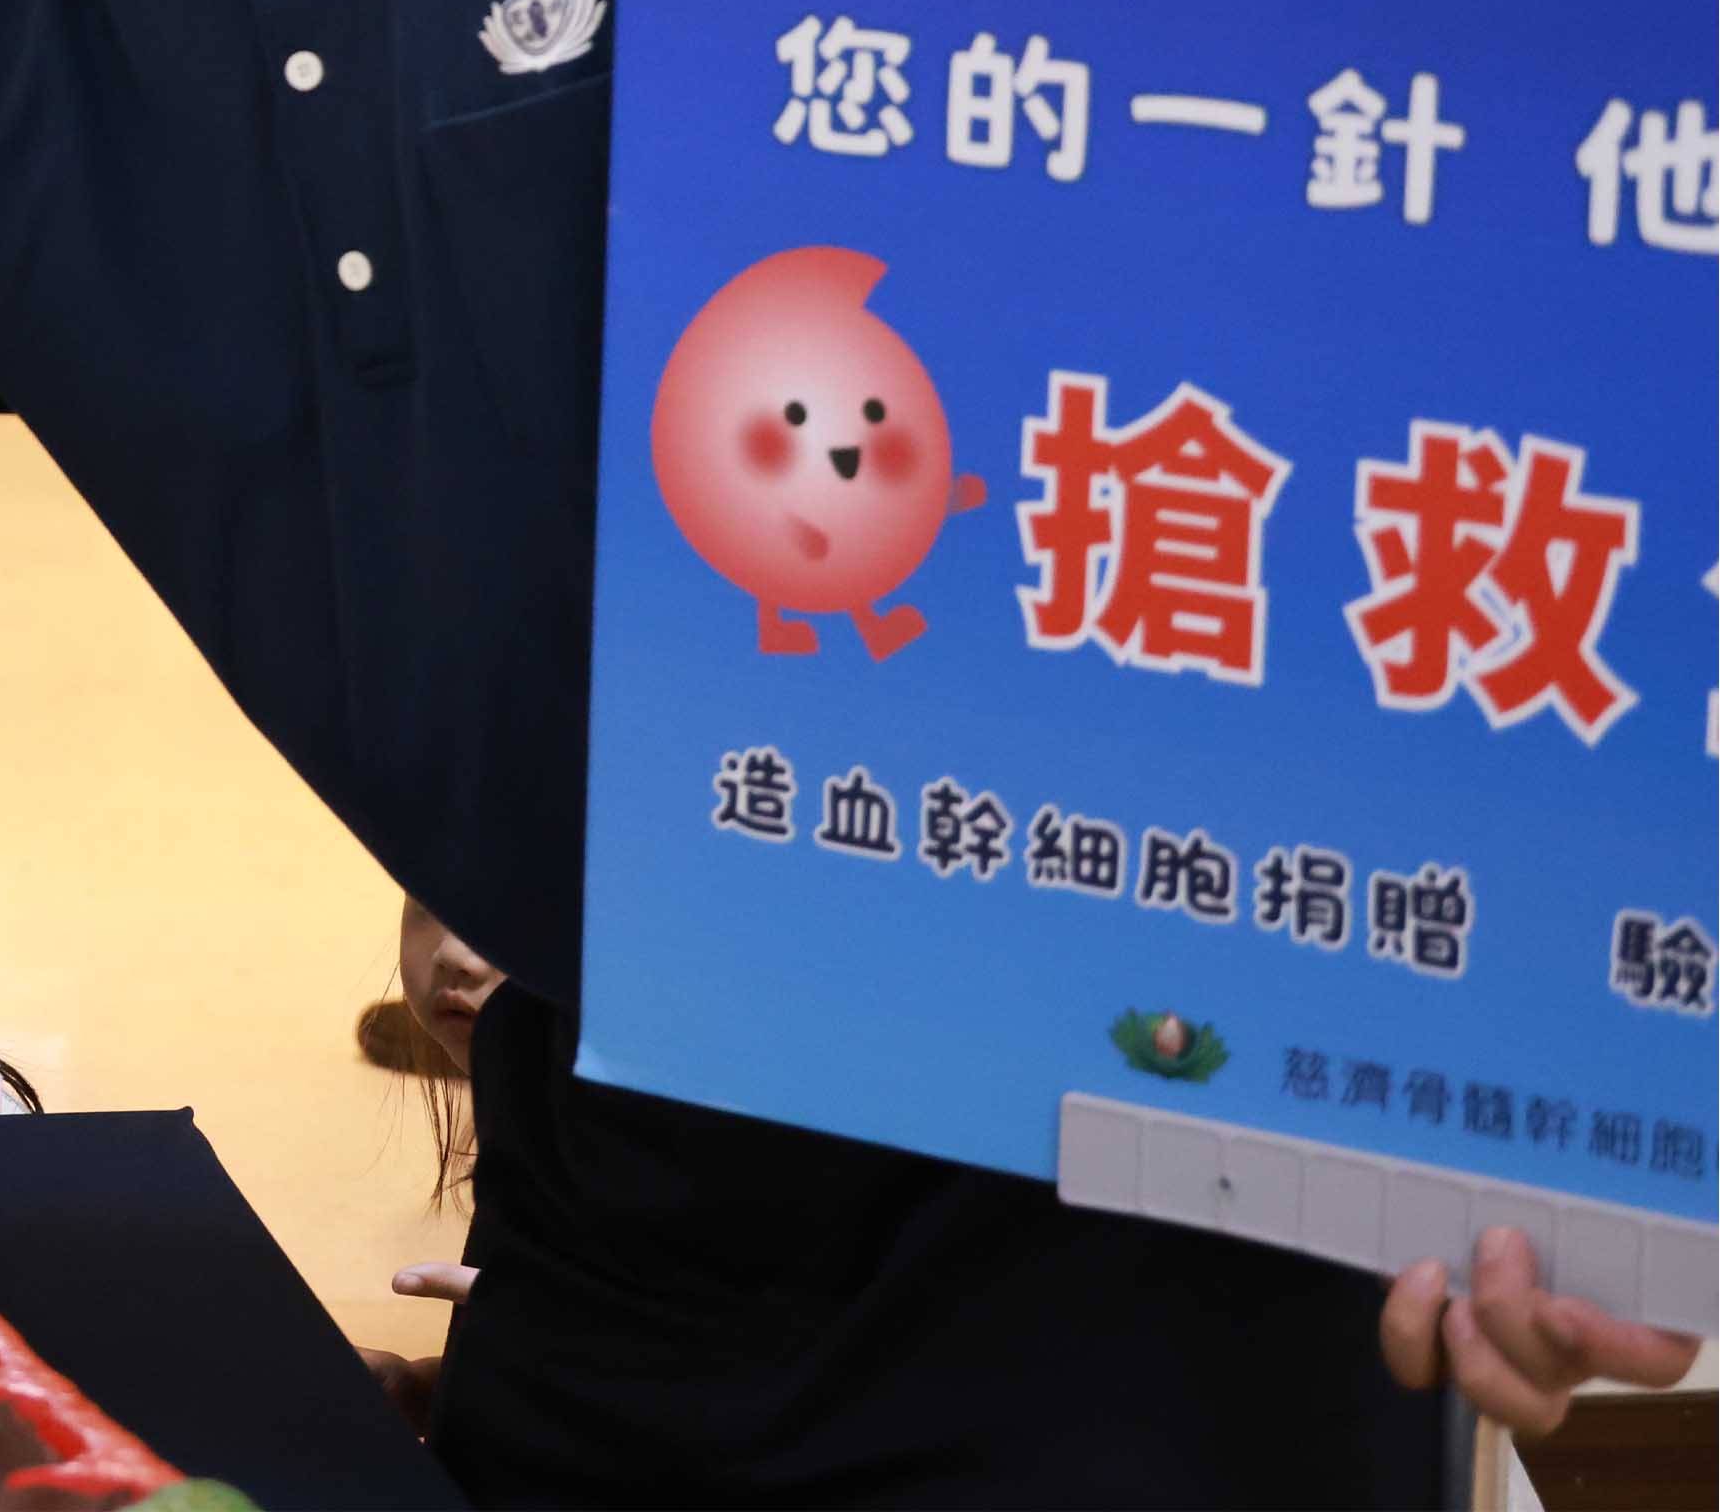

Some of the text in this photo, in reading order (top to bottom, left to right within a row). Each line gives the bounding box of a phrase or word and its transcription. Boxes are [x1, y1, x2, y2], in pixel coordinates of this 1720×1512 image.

[771, 14, 1465, 226] 您的一針
[1015, 369, 1719, 760] 搶救
[711, 745, 1716, 1020] 造血幹細胞捐贈 驗
[1278, 1045, 1719, 1184] 慈濟骨髓幹細胞
